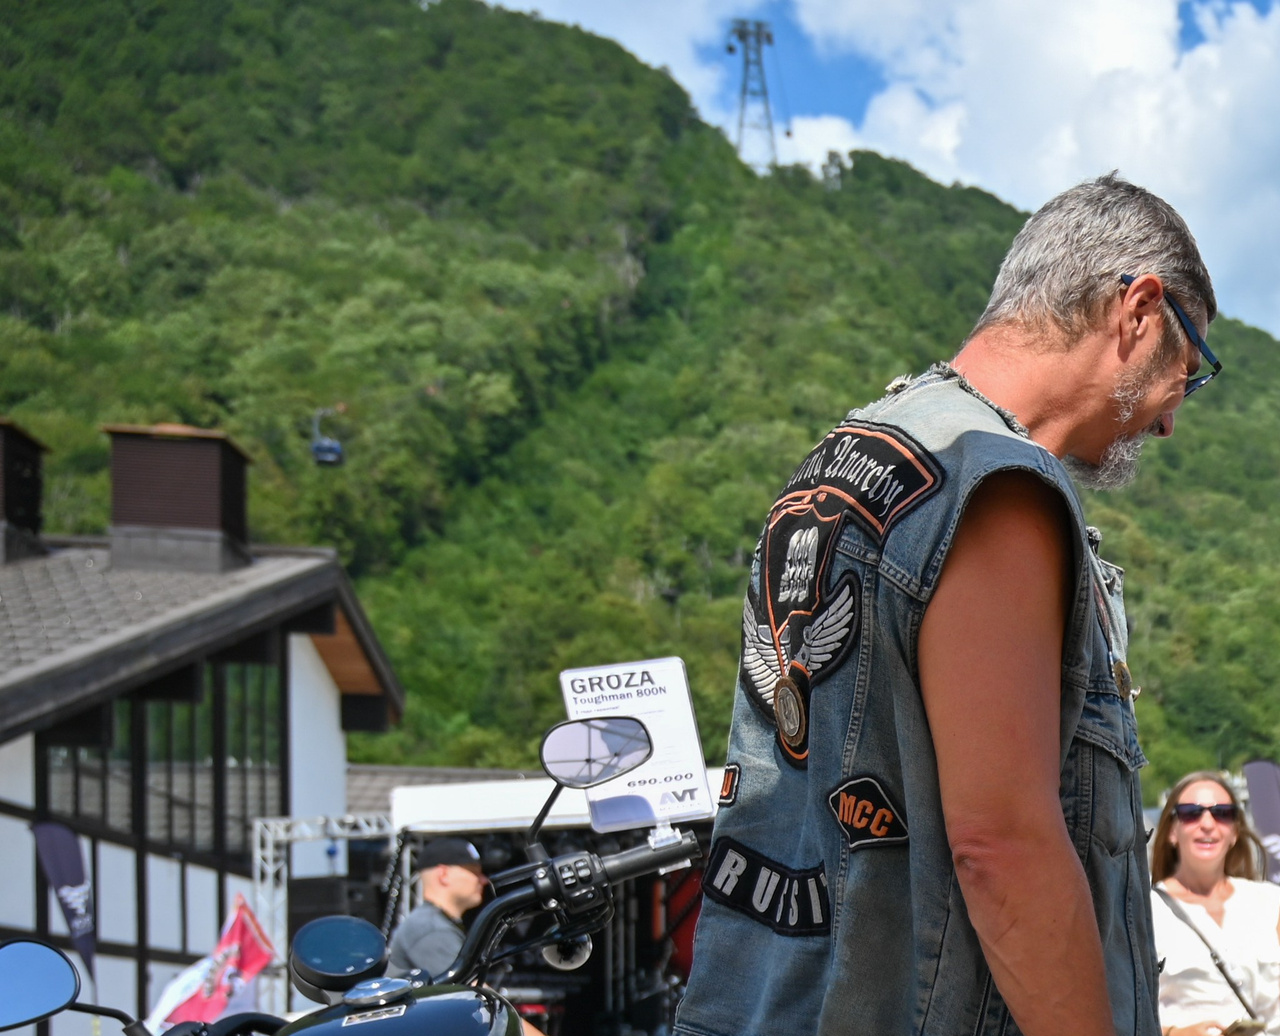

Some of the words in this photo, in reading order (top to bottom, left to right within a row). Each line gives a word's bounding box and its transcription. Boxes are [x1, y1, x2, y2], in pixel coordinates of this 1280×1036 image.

[823, 434, 904, 518] Anarchy
[570, 670, 656, 694] GROZA
[573, 691, 633, 706] Toughman
[636, 686, 667, 698] 800N
[627, 772, 694, 788] 690.000
[659, 787, 699, 805] AVT
[838, 791, 894, 838] MCC
[712, 848, 828, 927] RUSSI
